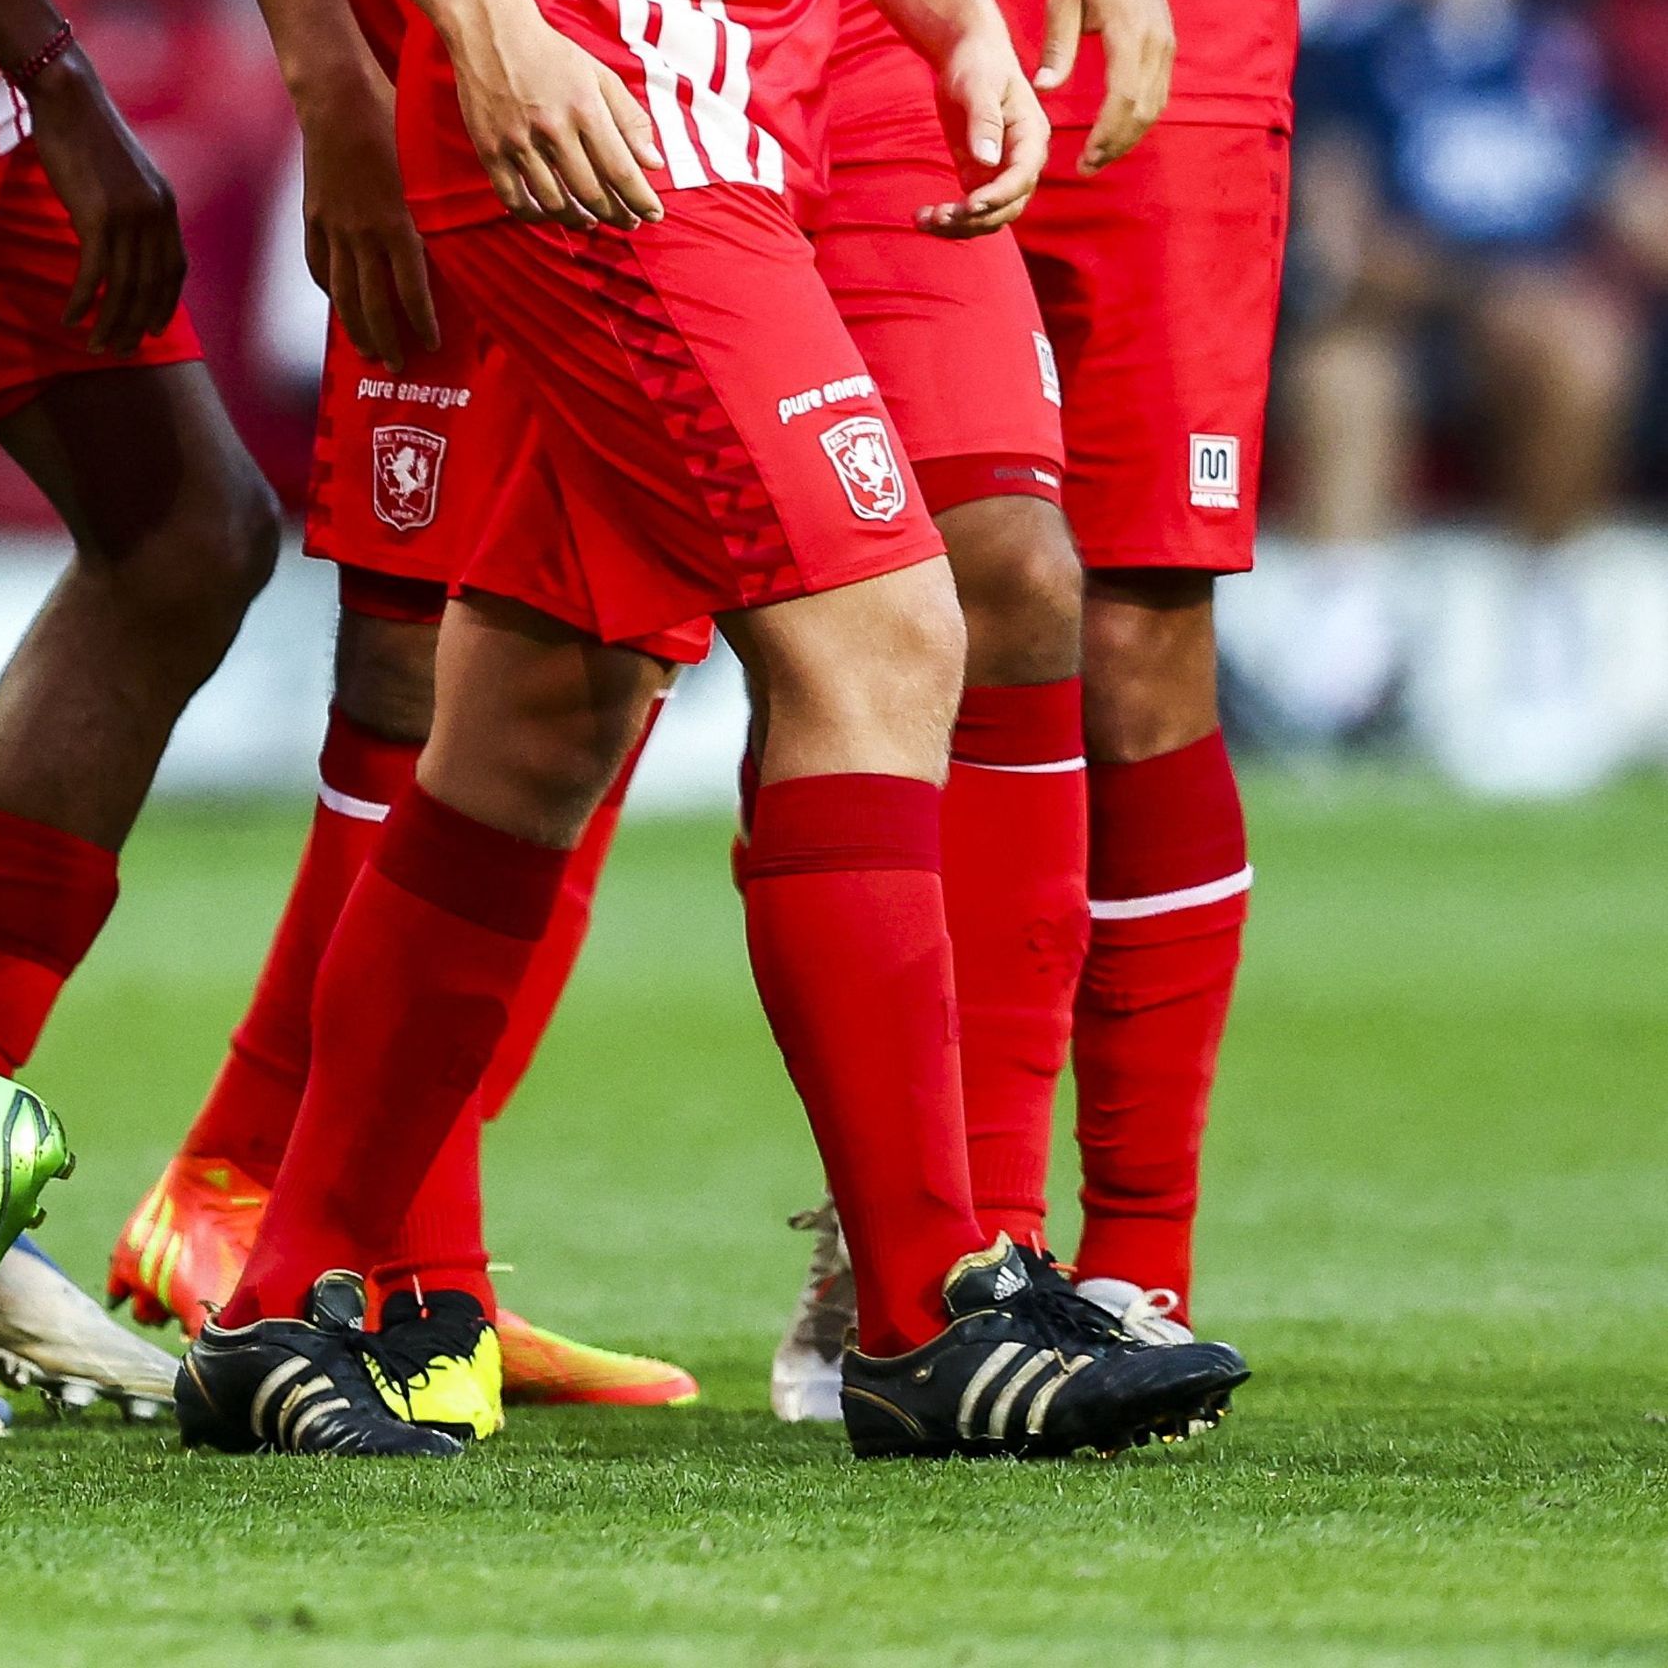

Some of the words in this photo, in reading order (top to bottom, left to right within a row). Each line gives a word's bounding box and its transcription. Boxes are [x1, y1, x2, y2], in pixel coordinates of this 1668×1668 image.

[357, 377, 395, 400] pure
[396, 383, 472, 409] energie
[778, 387, 824, 424] pure
